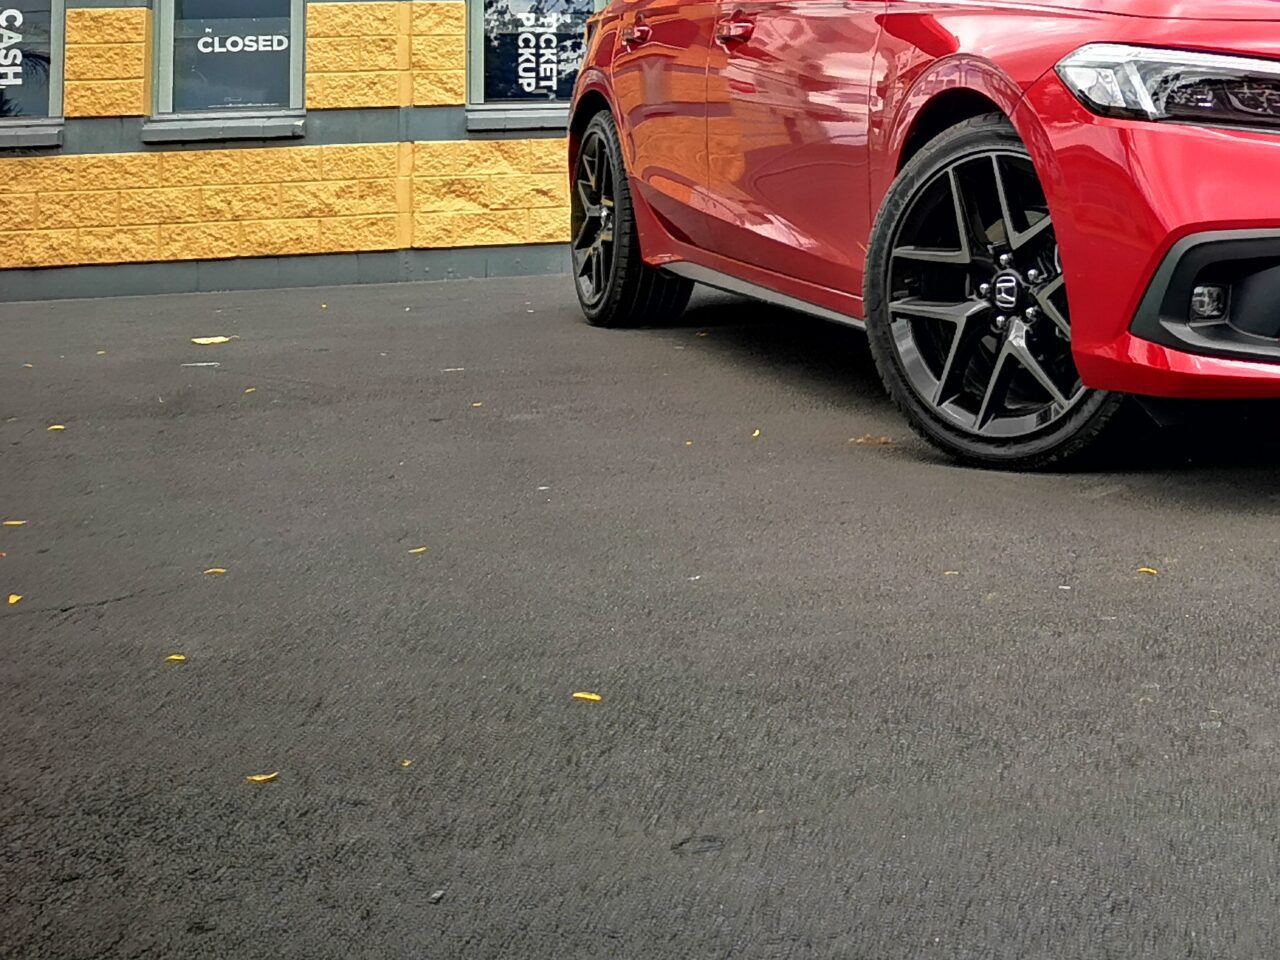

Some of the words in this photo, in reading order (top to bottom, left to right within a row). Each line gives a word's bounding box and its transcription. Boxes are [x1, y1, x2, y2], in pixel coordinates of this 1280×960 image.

[0, 8, 24, 85] CASH
[197, 35, 289, 53] CLOSED
[517, 12, 536, 93] PICKUP
[539, 12, 558, 91] TICKET
